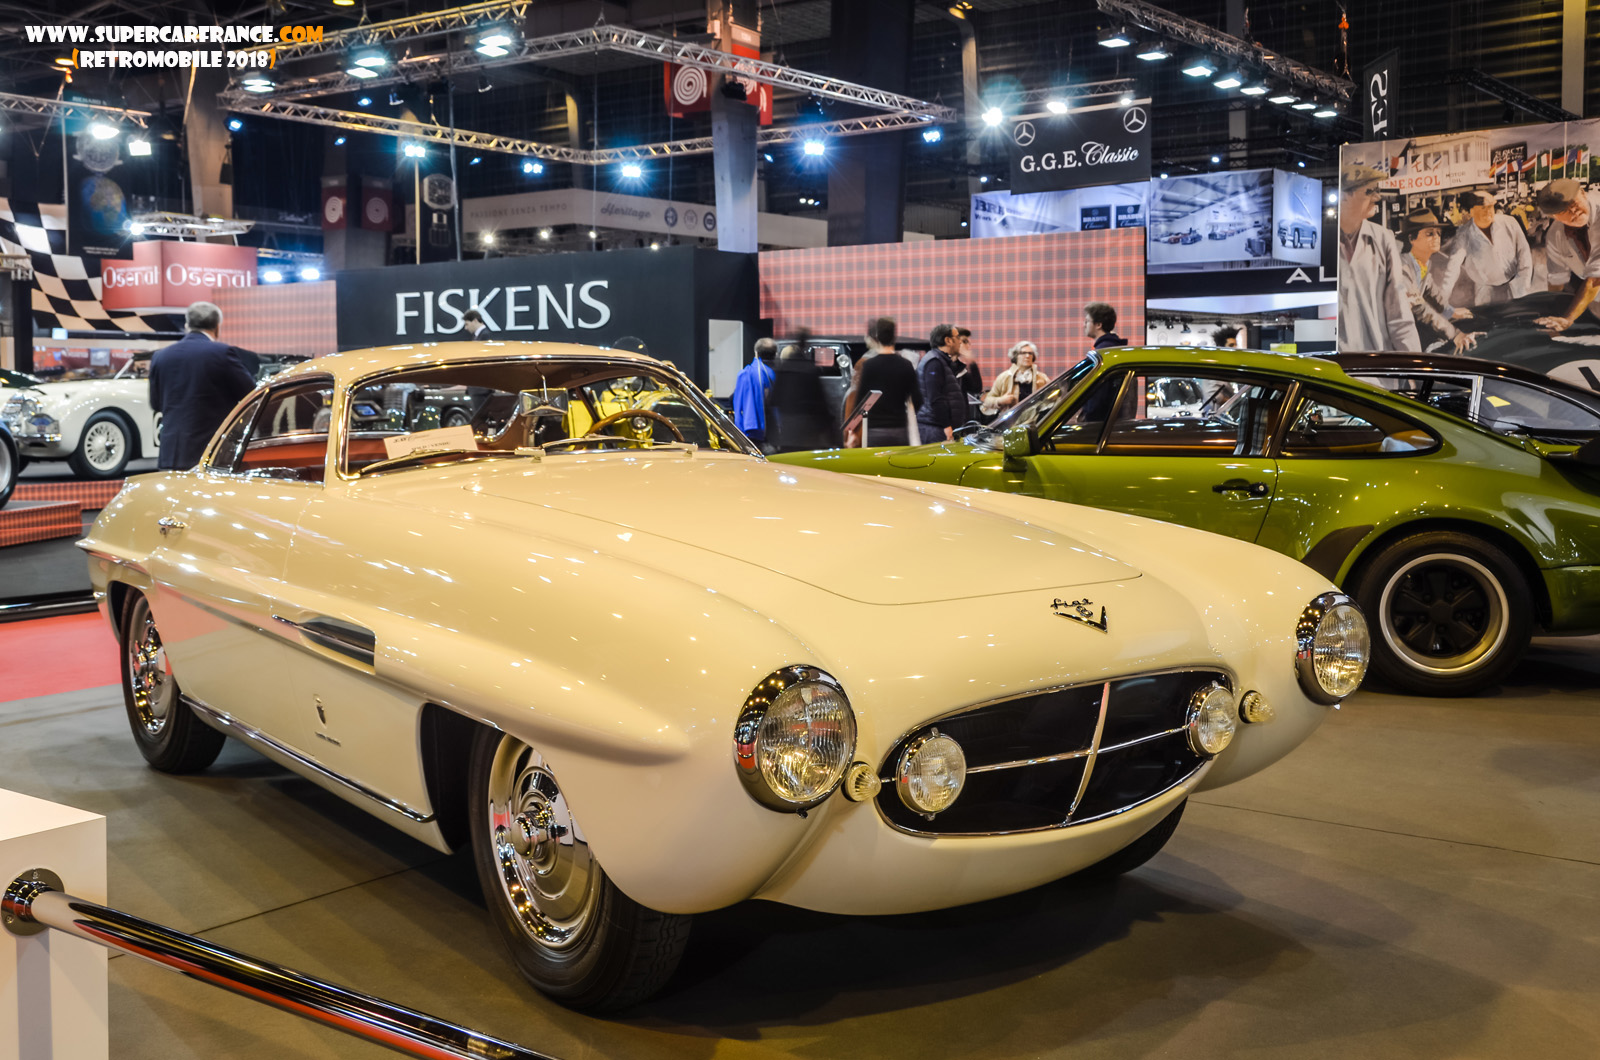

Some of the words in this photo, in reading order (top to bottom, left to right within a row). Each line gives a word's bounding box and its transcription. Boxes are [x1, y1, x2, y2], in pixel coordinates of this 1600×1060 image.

[1020, 150, 1082, 172] G.G.E.
[1081, 141, 1139, 166] Classic
[540, 203, 567, 213] TEMPO
[600, 203, 650, 221] Heritage
[103, 265, 160, 289] Osenat
[395, 280, 611, 335] FISKENS
